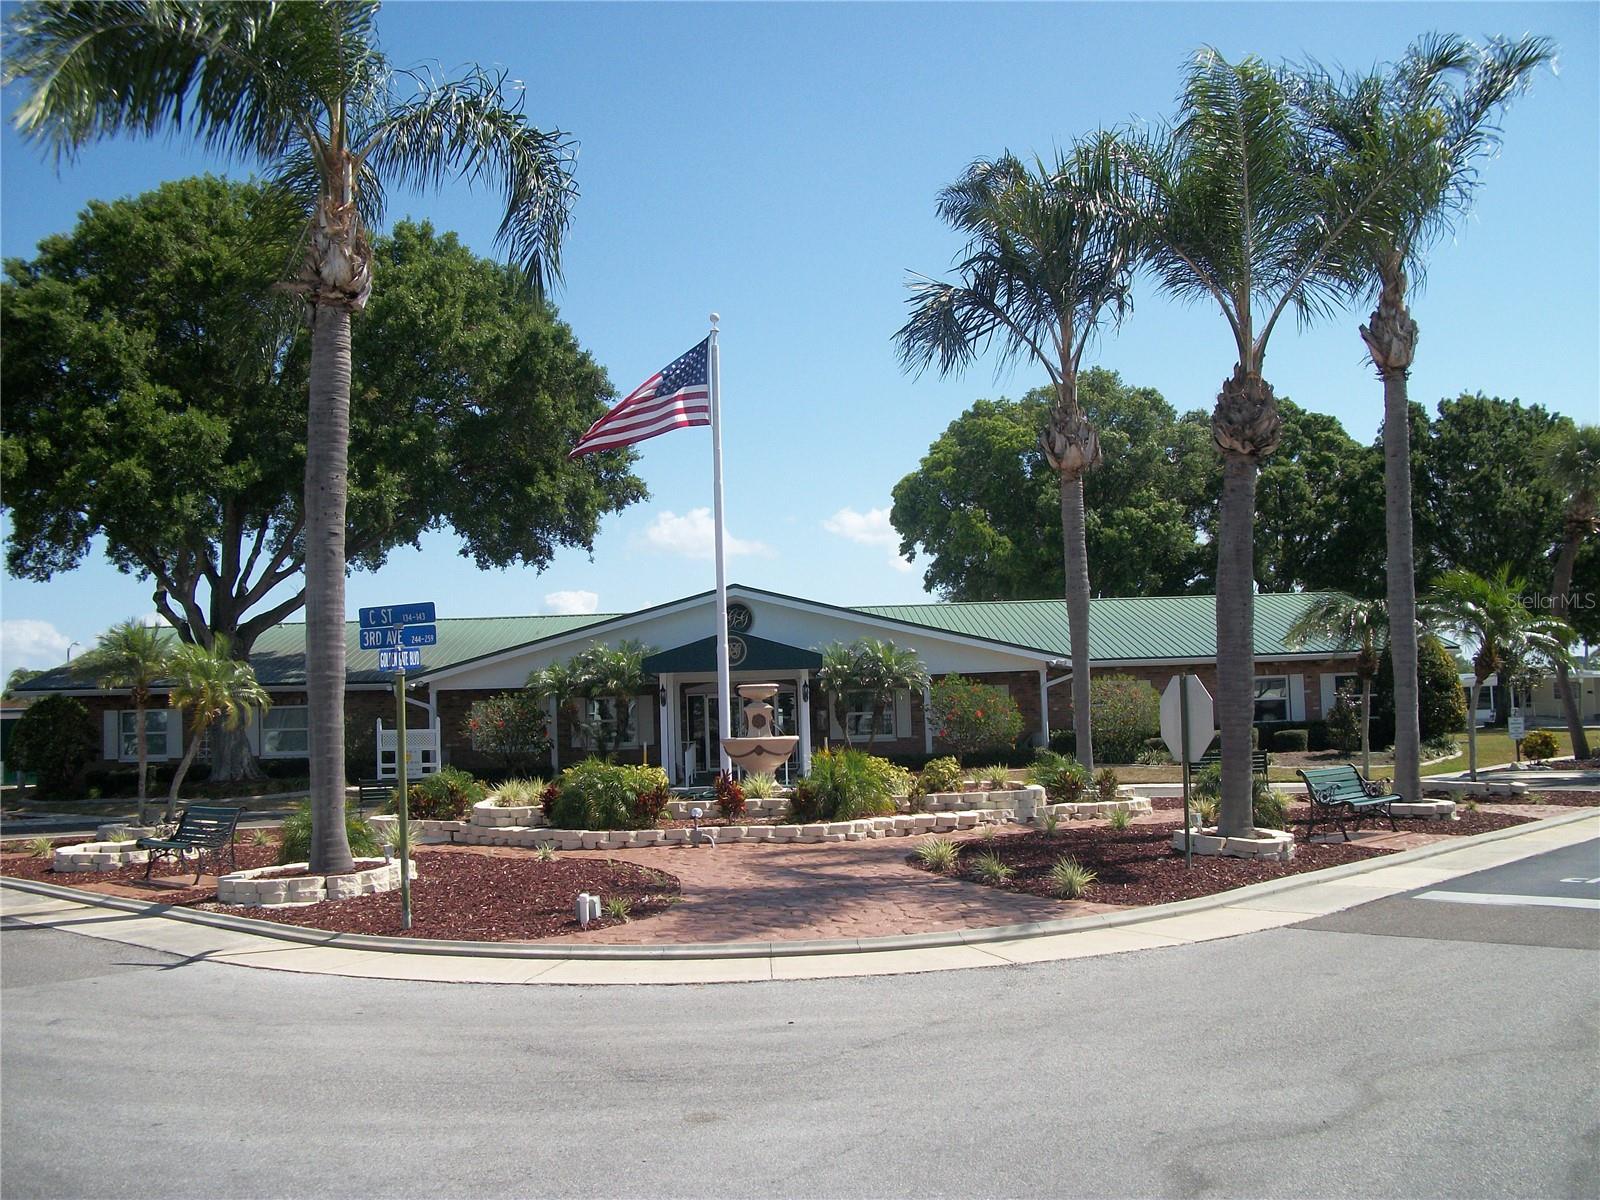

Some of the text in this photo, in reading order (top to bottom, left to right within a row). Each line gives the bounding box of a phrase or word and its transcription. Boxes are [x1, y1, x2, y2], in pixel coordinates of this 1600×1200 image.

[369, 610, 376, 625] C
[380, 608, 393, 624] ST
[363, 631, 382, 647] 3RD
[386, 630, 403, 645] AVE
